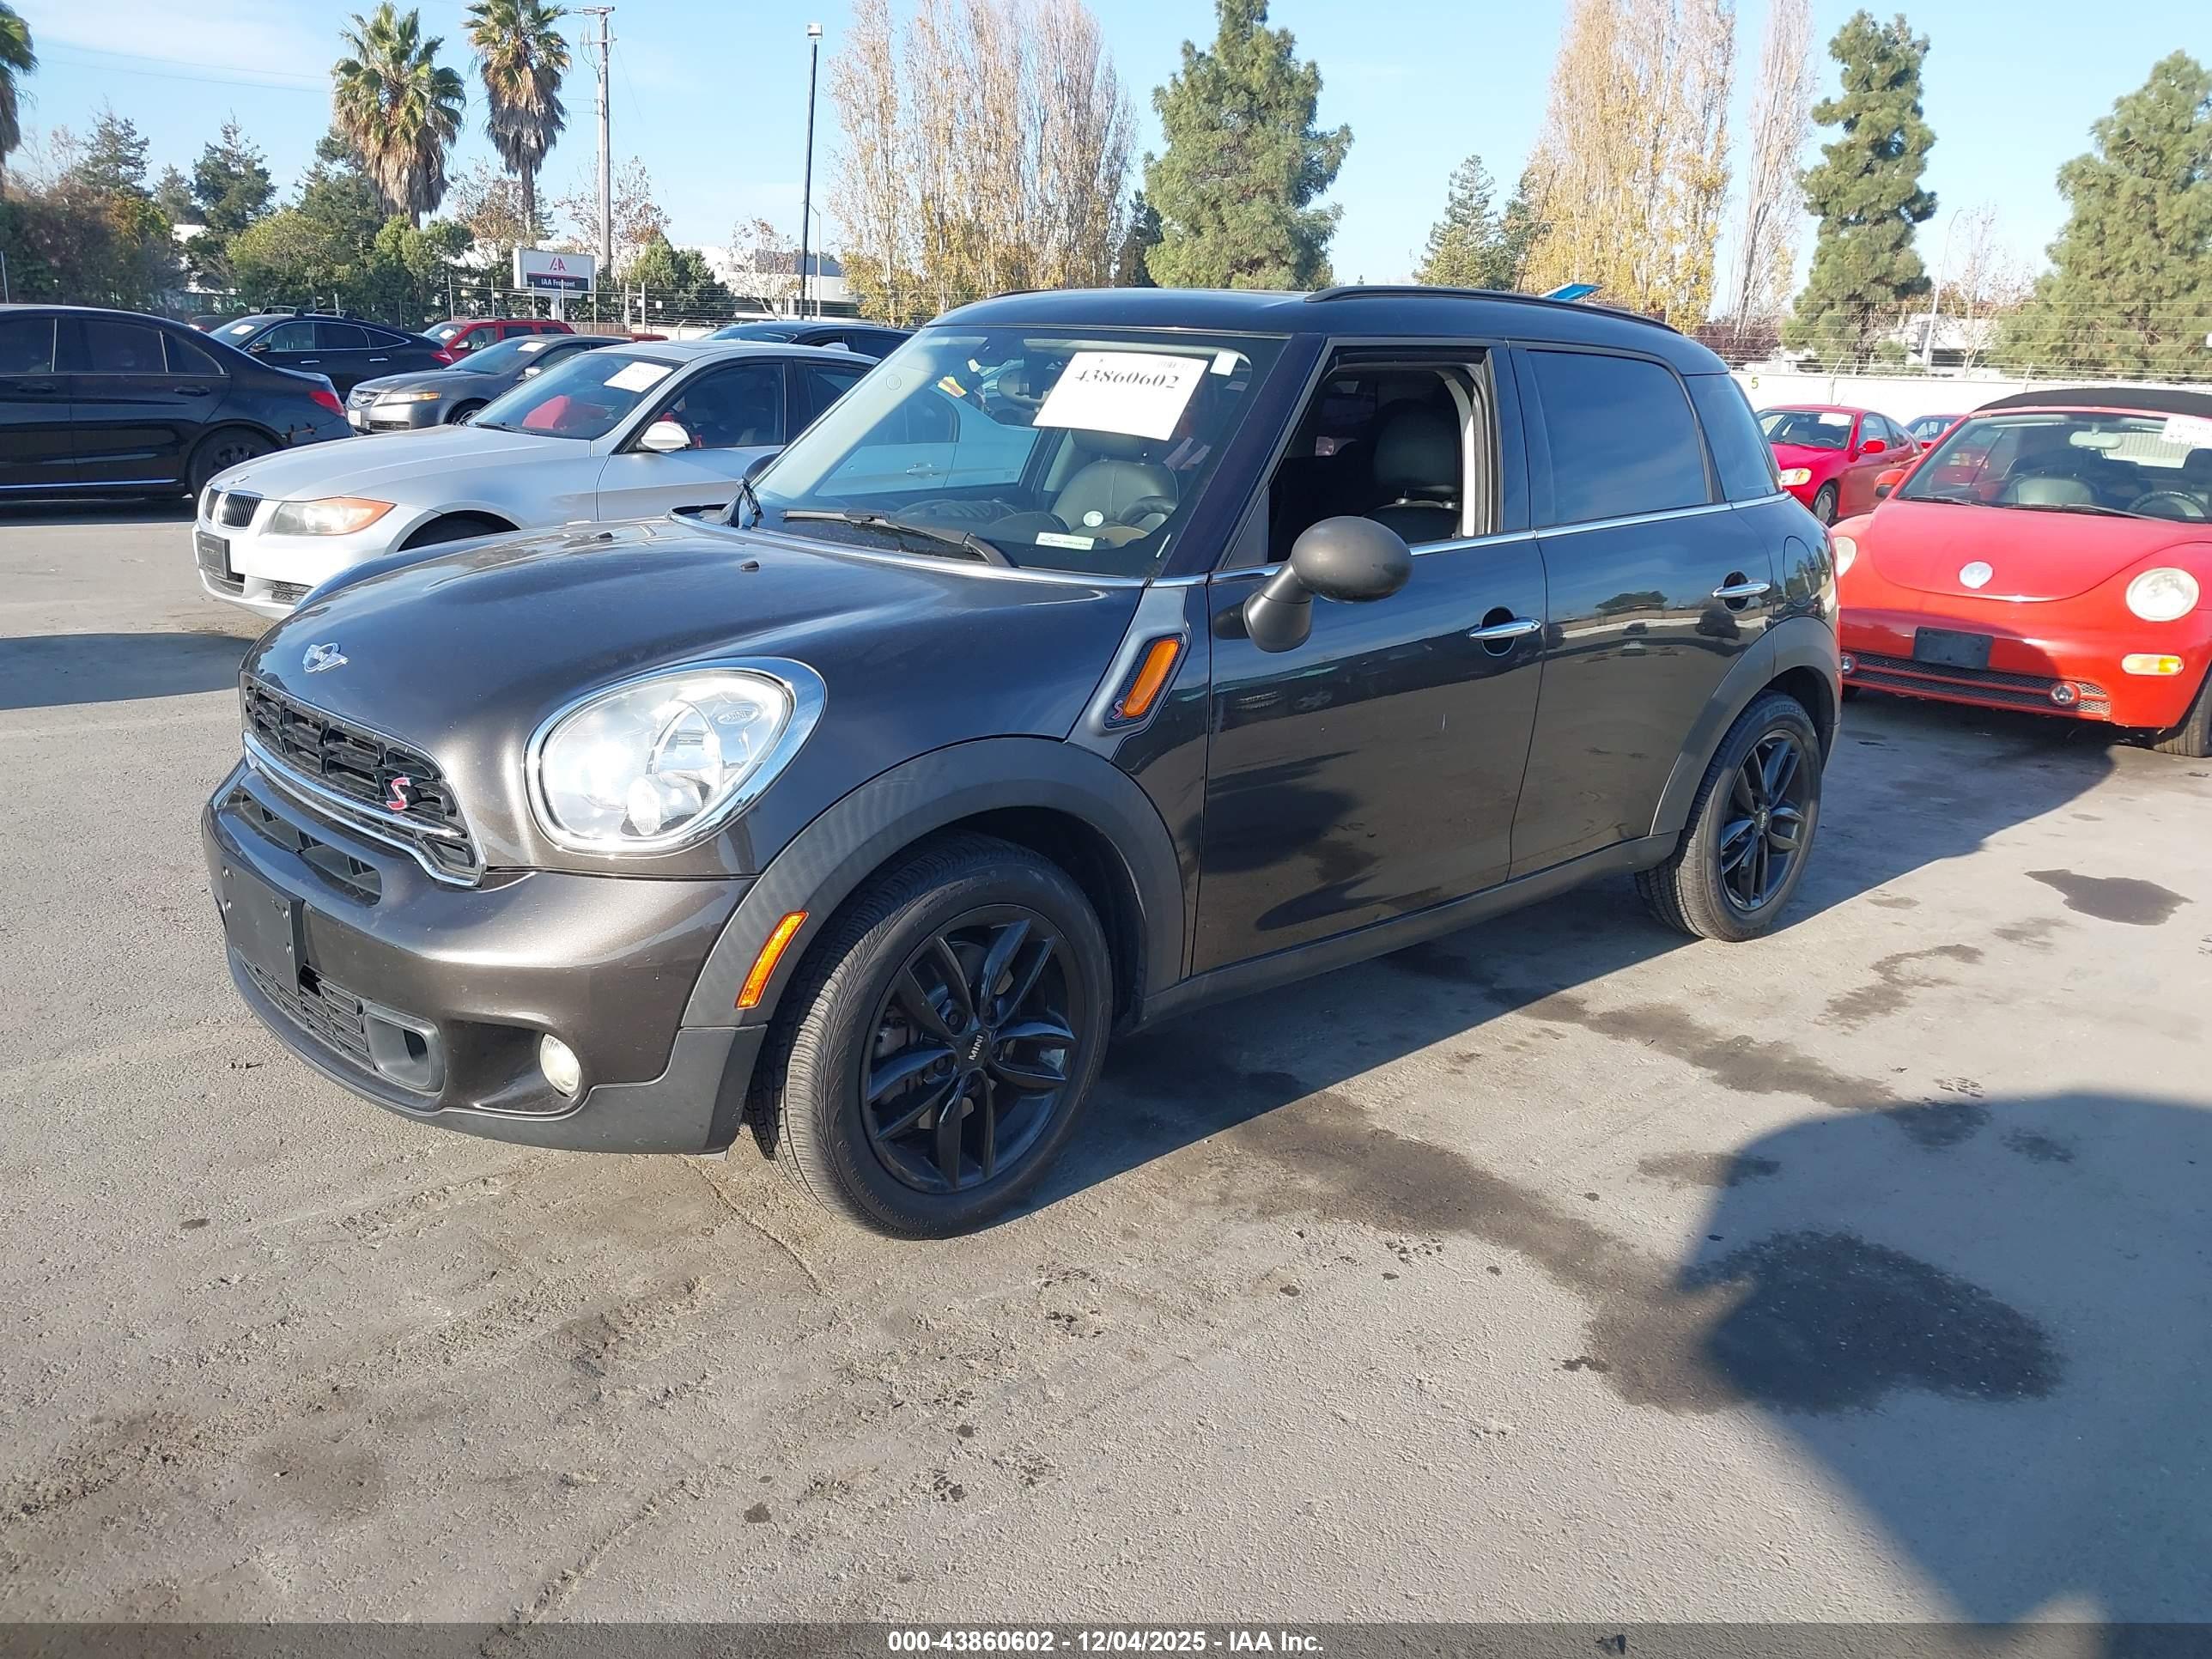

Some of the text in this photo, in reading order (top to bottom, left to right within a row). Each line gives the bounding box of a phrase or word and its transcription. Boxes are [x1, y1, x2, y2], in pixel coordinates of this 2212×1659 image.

[541, 277, 552, 286] IAA
[1075, 369, 1180, 389] 43860602
[386, 776, 411, 811] S
[968, 1035, 984, 1060] MINI
